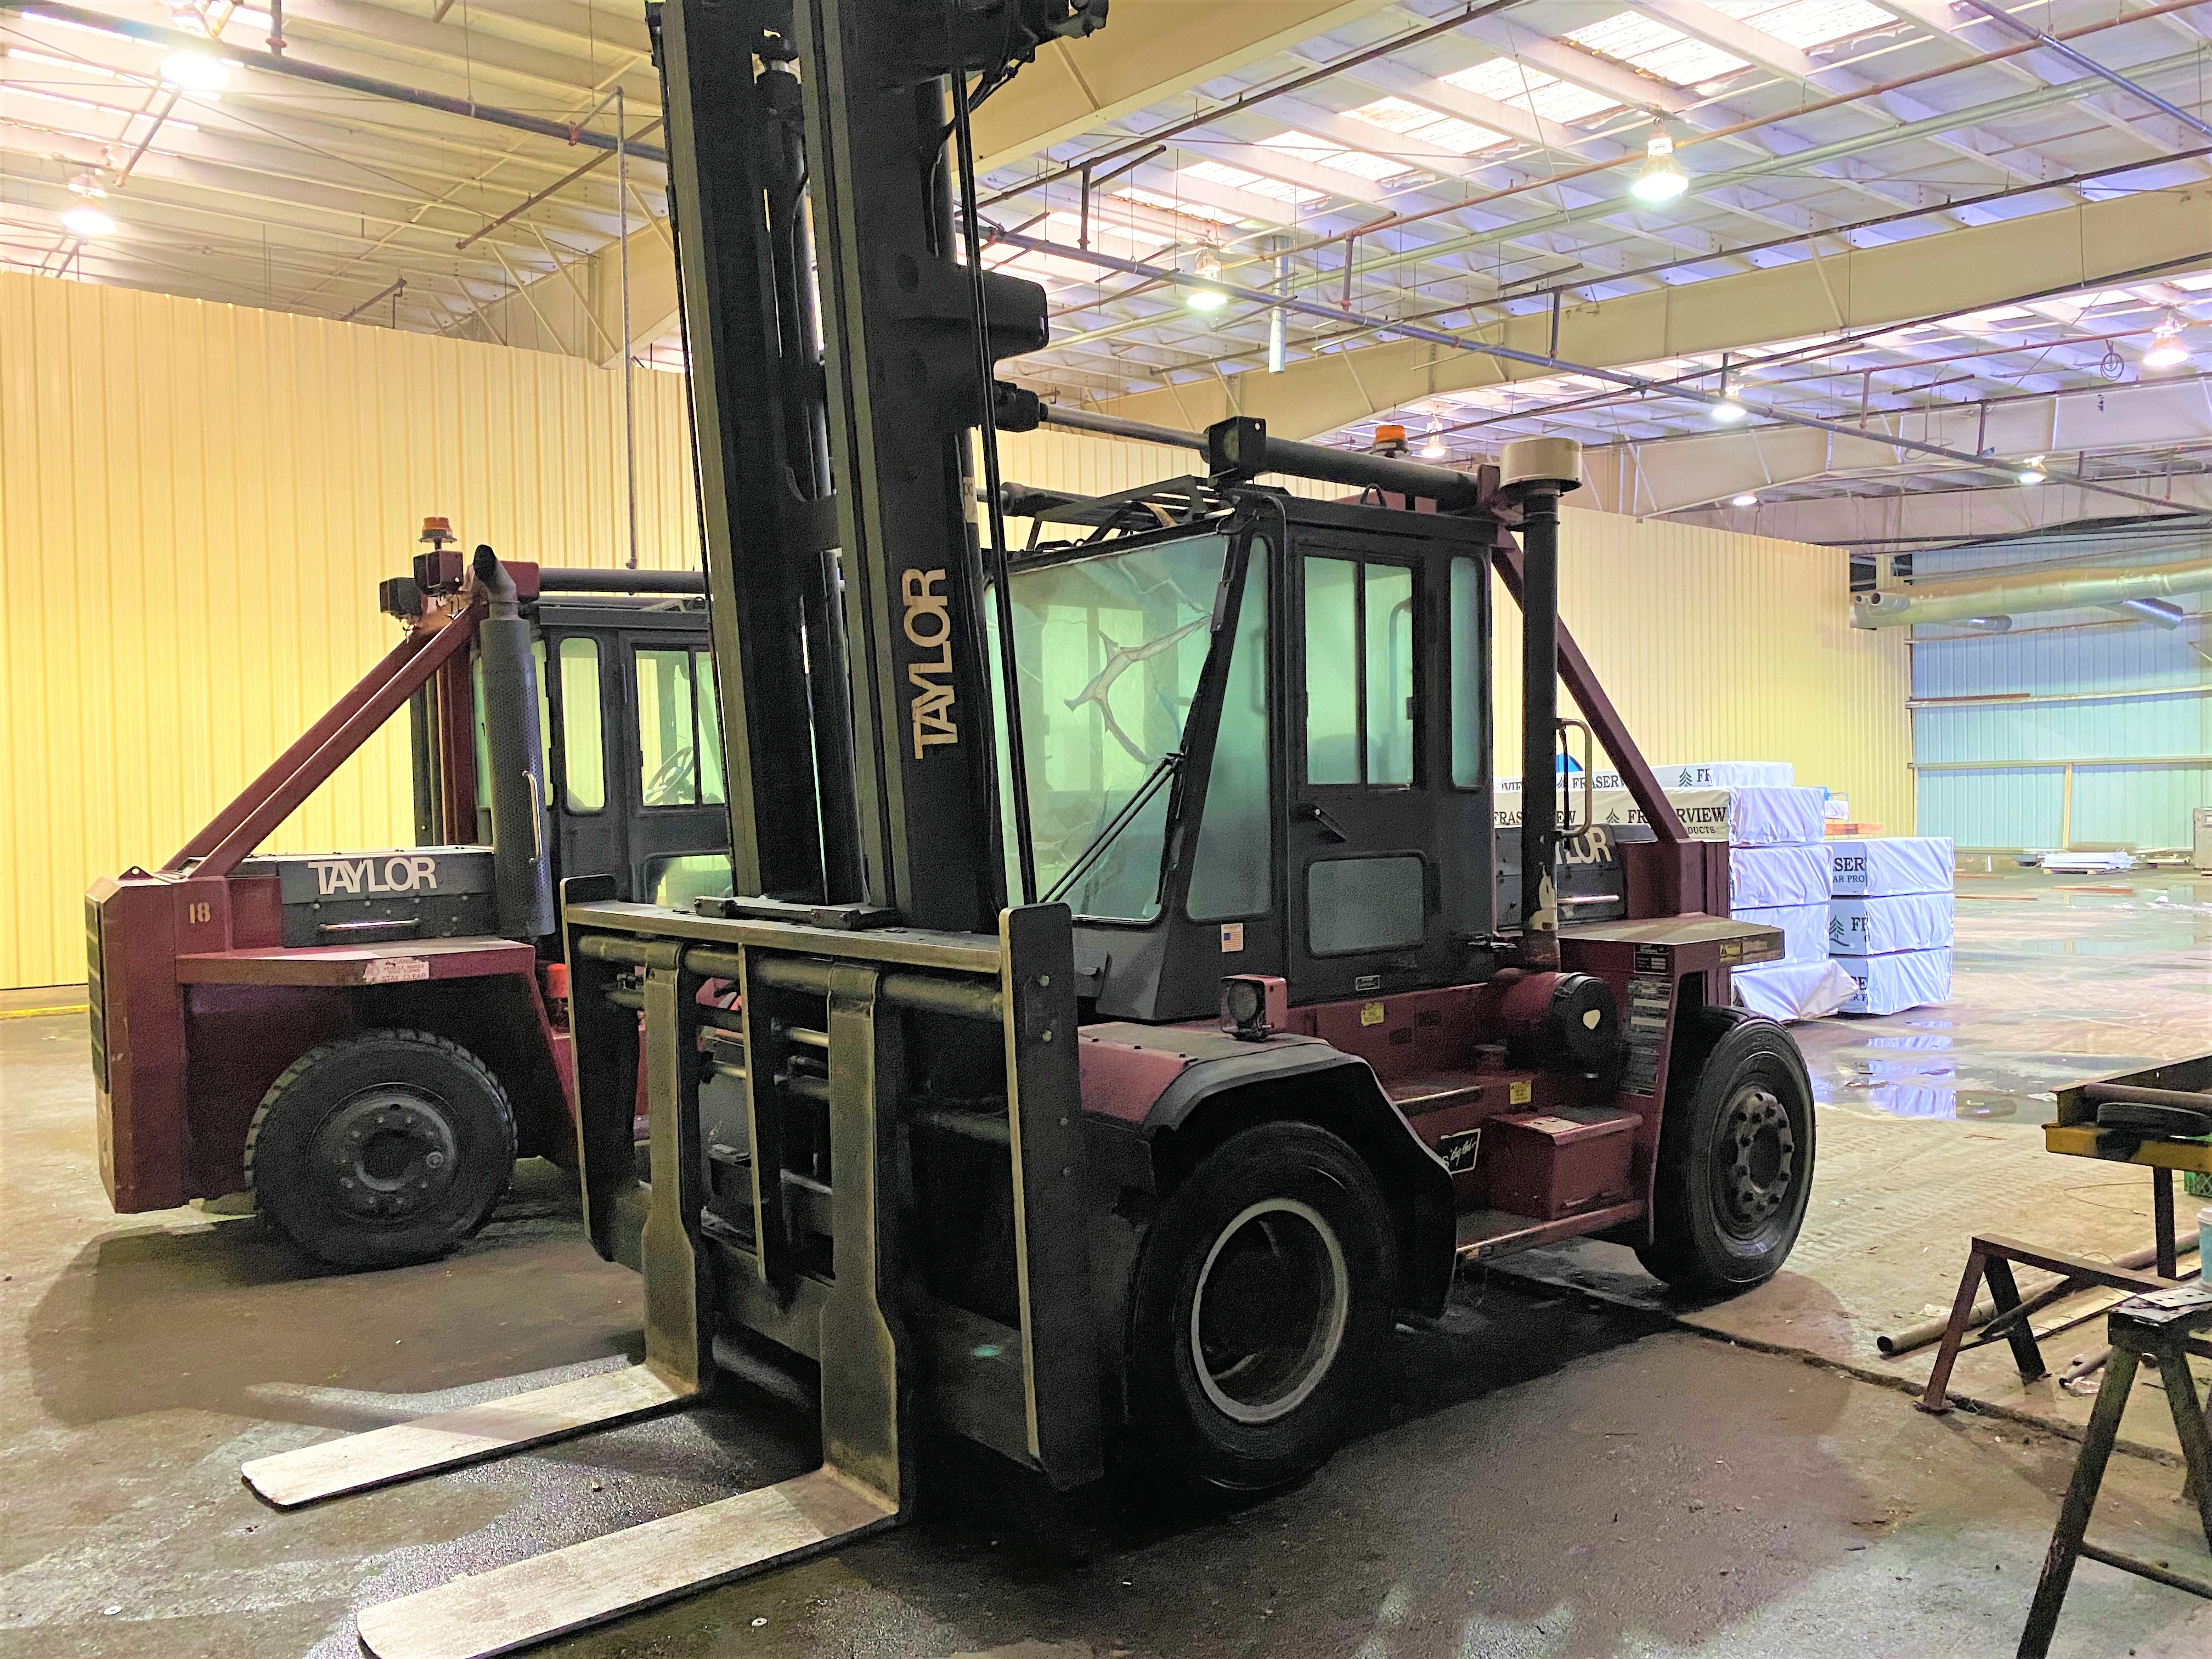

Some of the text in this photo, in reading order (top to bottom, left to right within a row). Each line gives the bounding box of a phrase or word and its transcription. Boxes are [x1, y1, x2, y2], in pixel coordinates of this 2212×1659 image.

[901, 568, 958, 760] TAYLOR
[1627, 807, 1727, 823] FRRVIEW
[1688, 826, 1716, 834] DUCTS
[1833, 857, 1867, 871] SER
[308, 857, 437, 895] TAYLOR
[1847, 874, 1866, 883] PRO
[189, 901, 211, 924] 18
